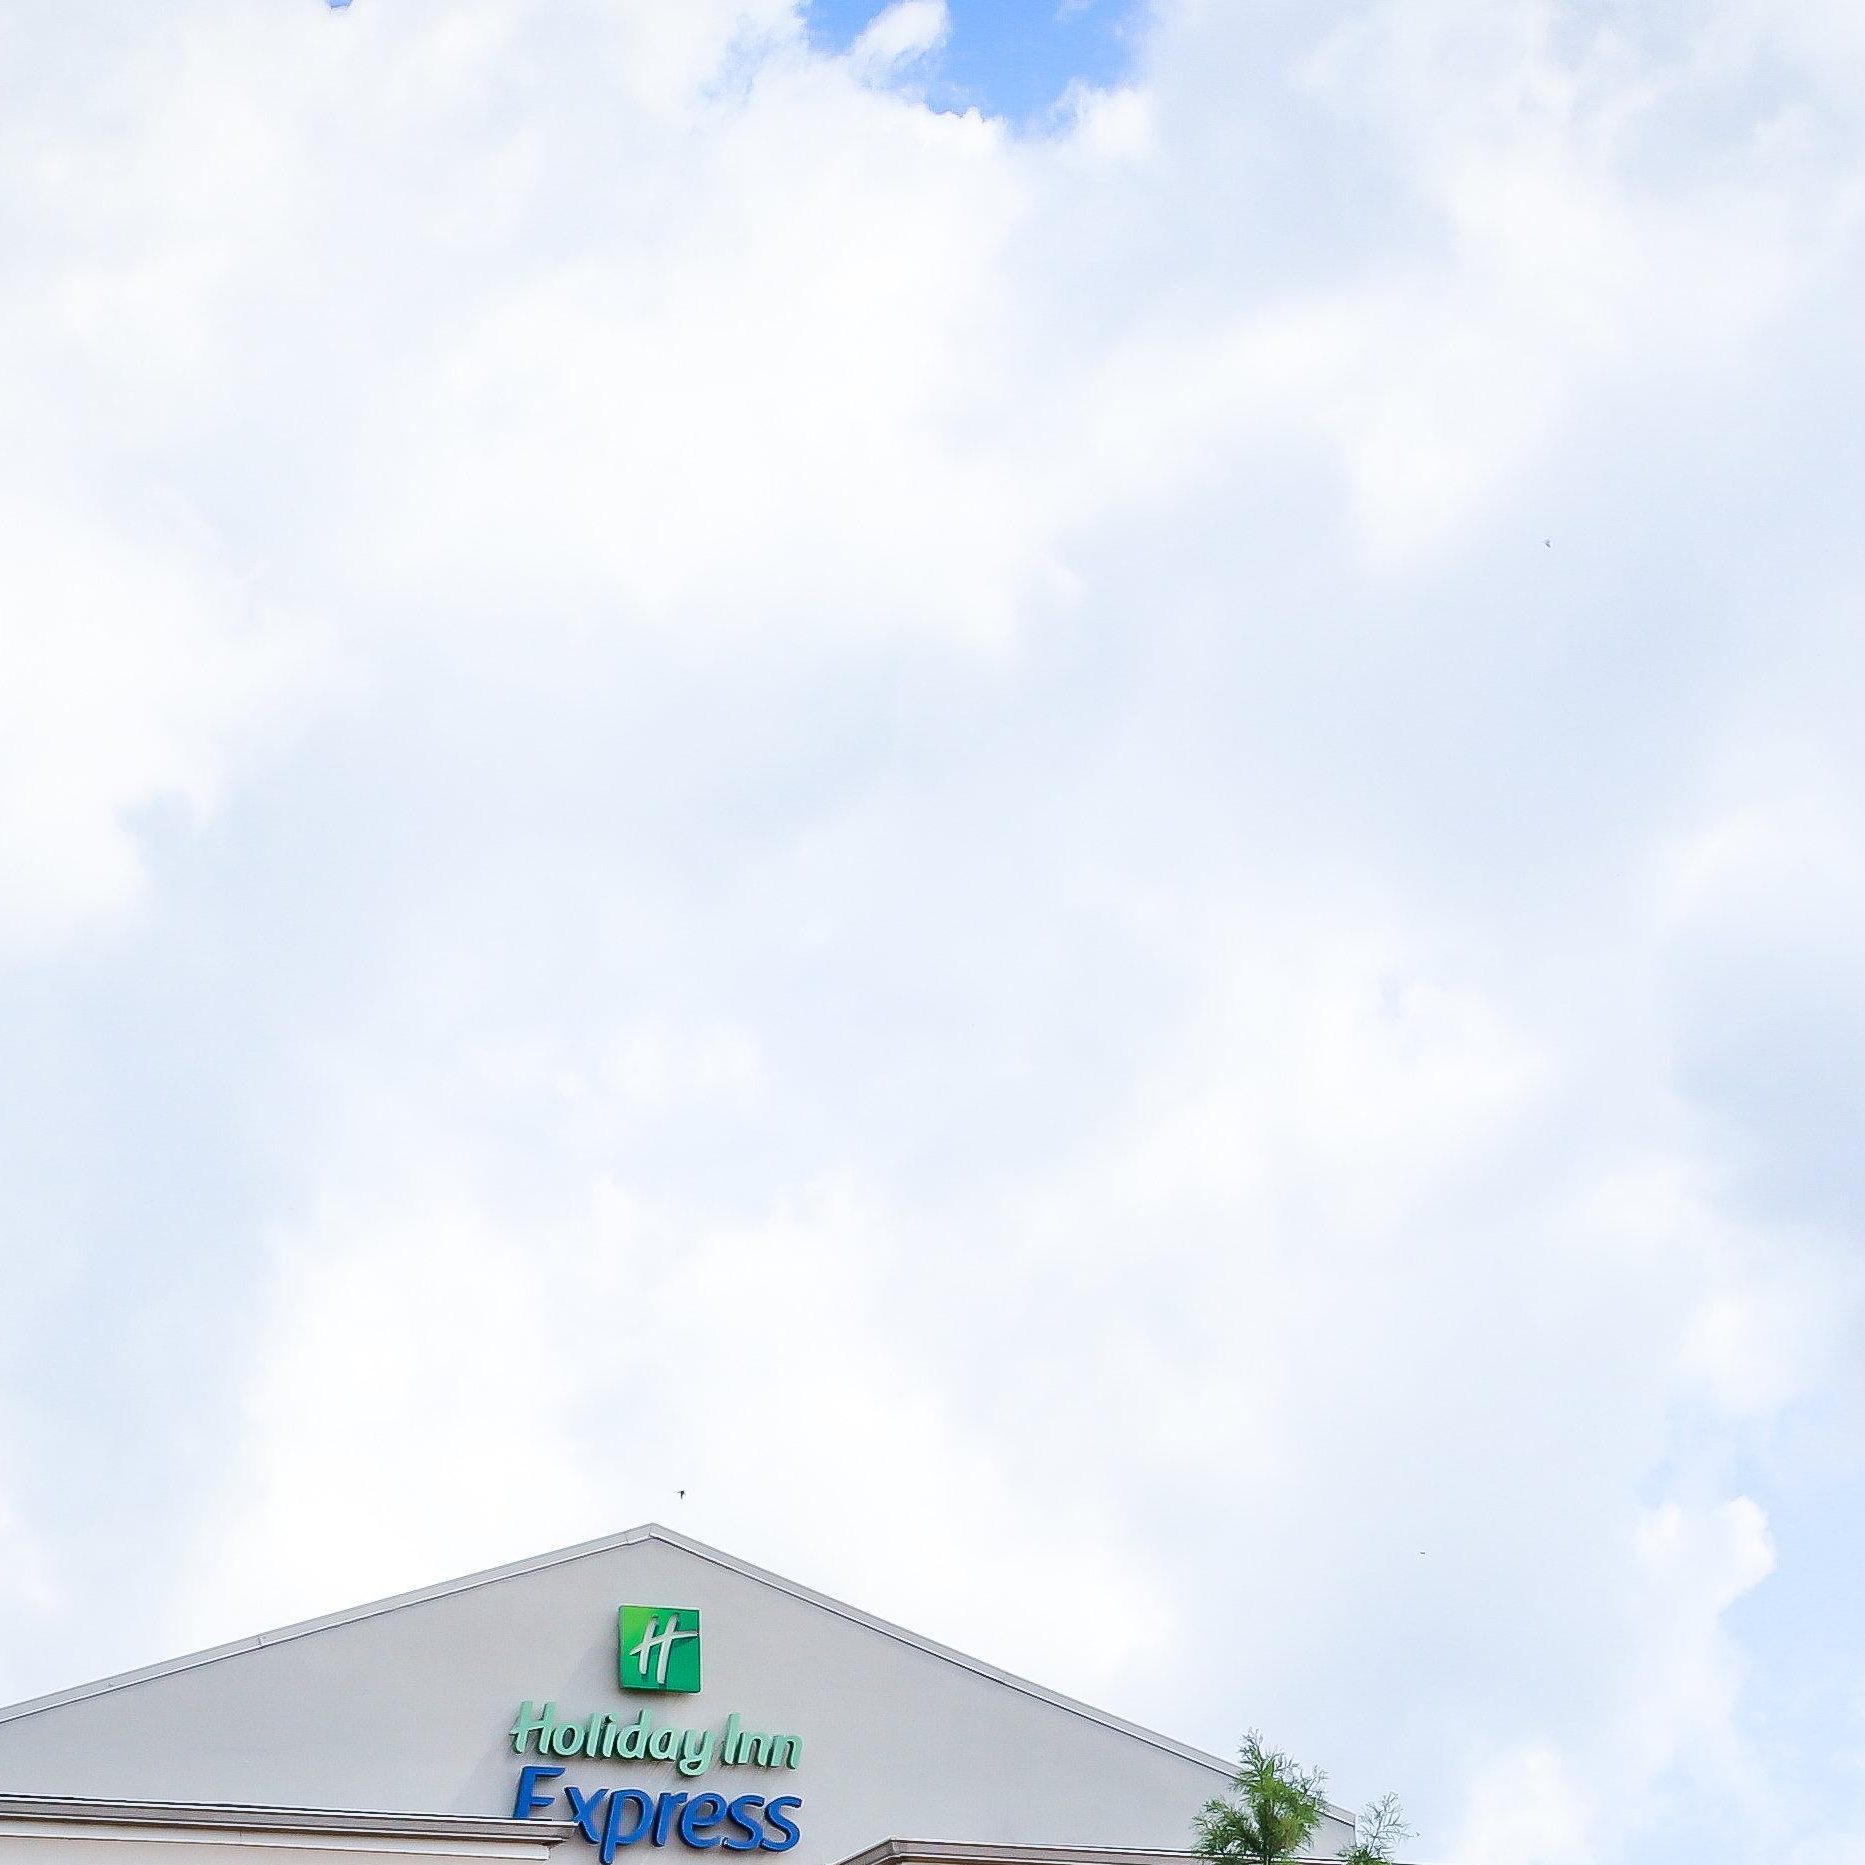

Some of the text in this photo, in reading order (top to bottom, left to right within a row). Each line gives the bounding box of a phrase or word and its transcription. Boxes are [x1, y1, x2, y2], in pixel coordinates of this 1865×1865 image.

[509, 1700, 803, 1778] Holiday Inn
[513, 1765, 802, 1865] Express
